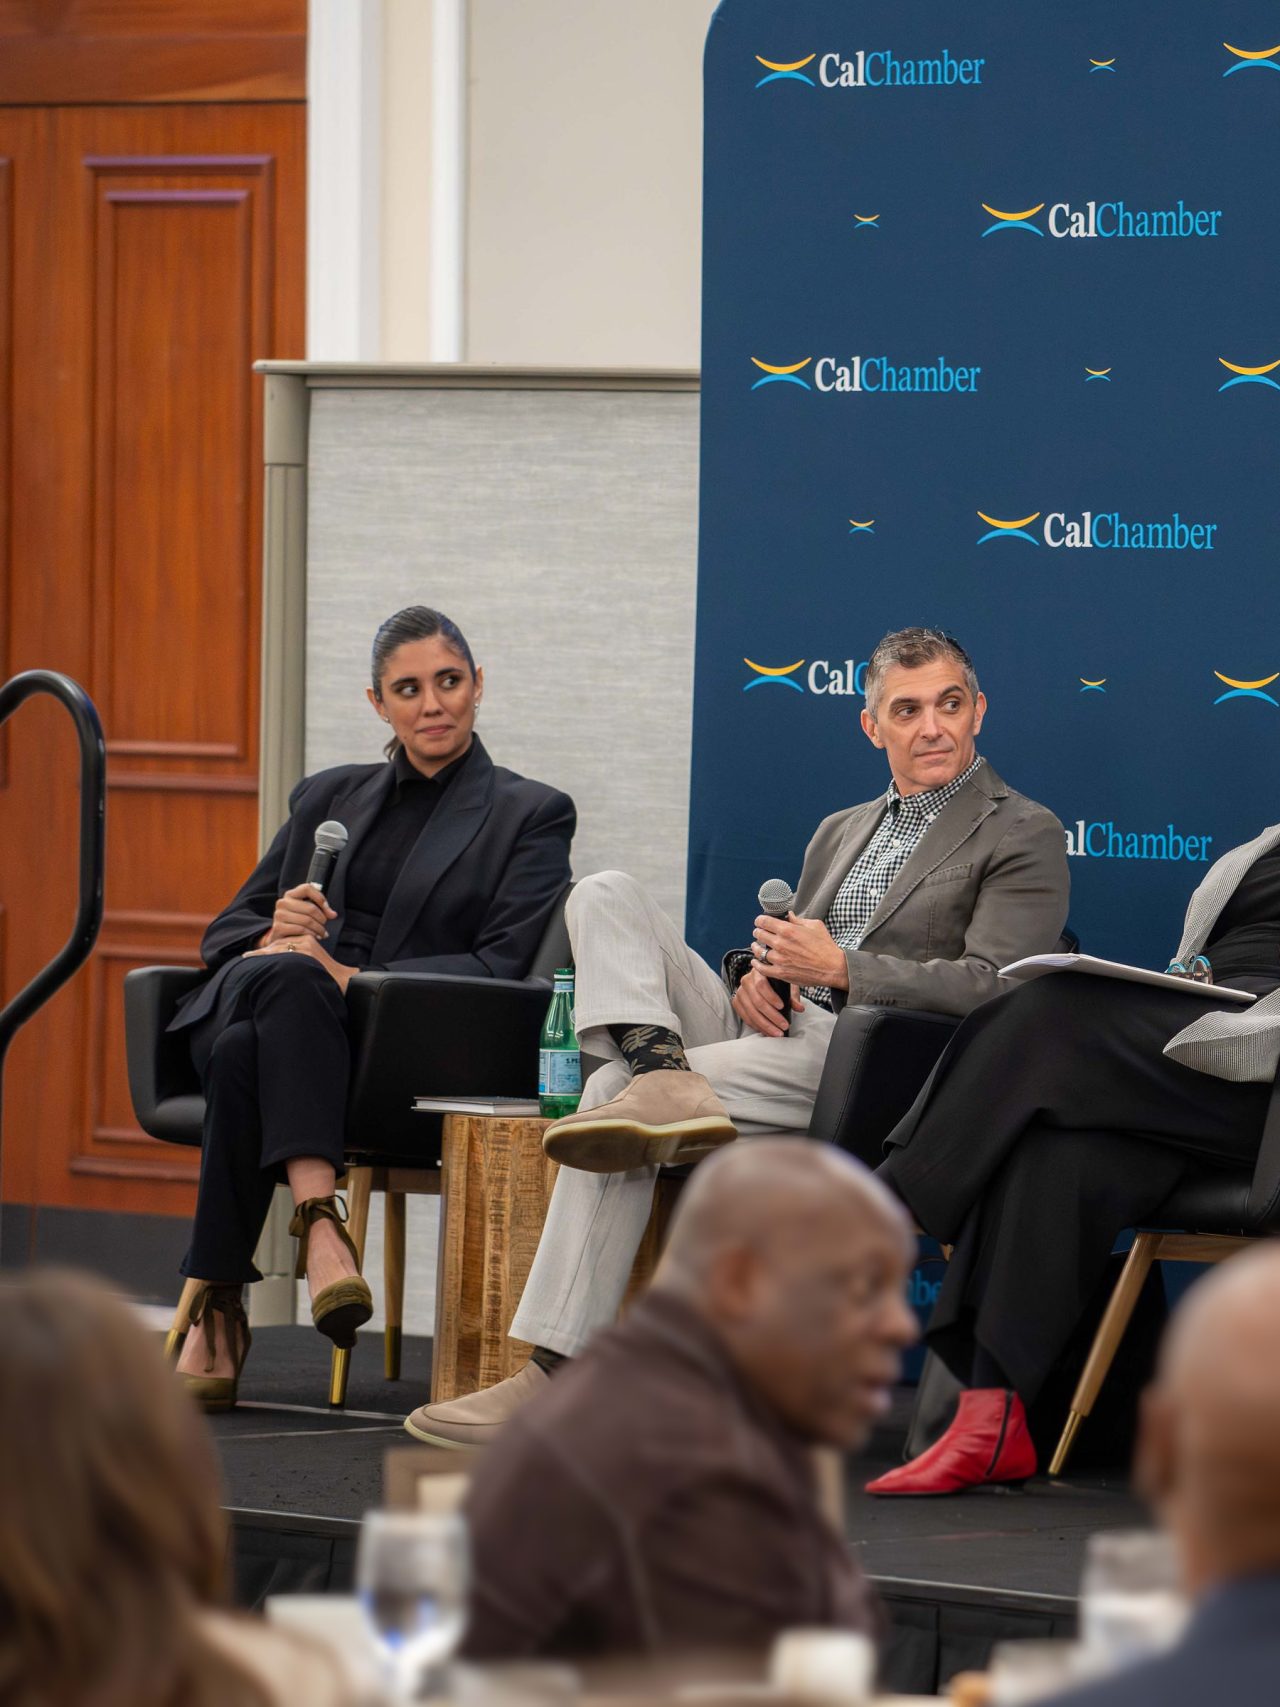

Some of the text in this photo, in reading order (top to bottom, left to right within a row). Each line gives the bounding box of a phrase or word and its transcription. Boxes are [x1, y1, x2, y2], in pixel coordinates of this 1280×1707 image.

[818, 49, 985, 87] CalChamber
[1048, 201, 1221, 238] CalChamber
[815, 356, 981, 392] CalChamber
[1044, 512, 1217, 549] CalChamber
[1065, 820, 1212, 861] alChamber
